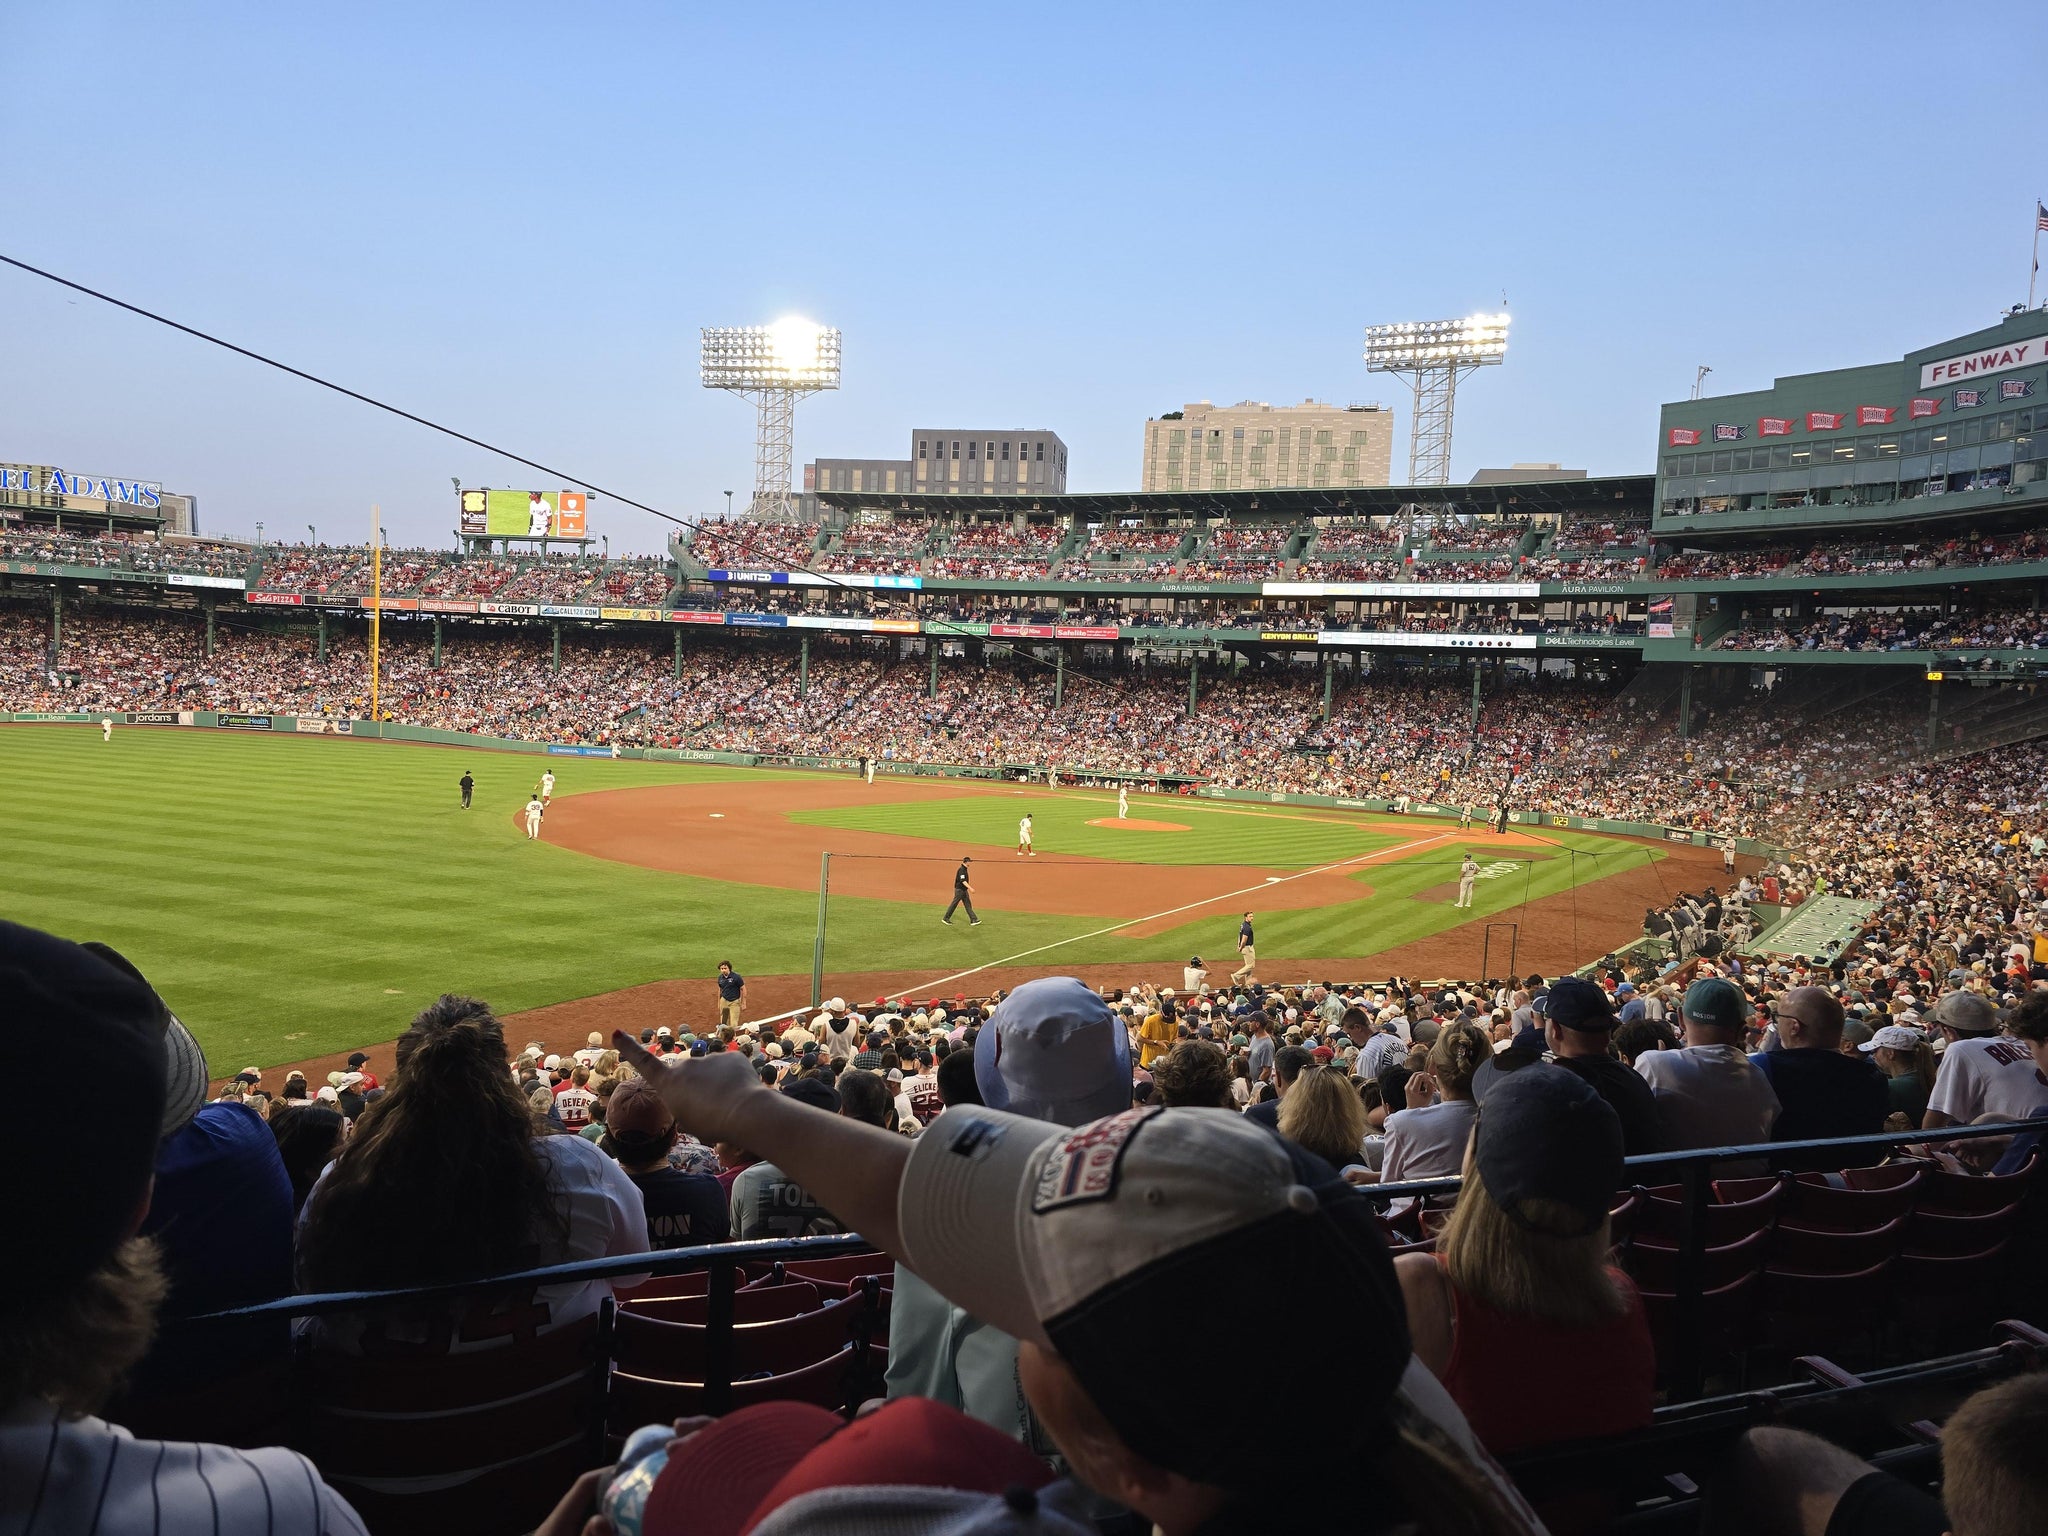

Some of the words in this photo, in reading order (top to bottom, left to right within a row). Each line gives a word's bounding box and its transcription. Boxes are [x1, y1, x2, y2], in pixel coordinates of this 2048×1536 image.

[1932, 345, 2029, 381] FENWAY
[43, 469, 161, 509] ADAMS
[272, 596, 295, 604] PIZZA
[422, 601, 443, 610] King's
[443, 602, 476, 611] Hawaiian
[1545, 637, 1567, 645] DELL
[1567, 637, 1614, 647] Technologies
[679, 751, 715, 760] L.L.Bean
[1692, 1010, 1716, 1020] BOSTON
[562, 1097, 591, 1107] DEVERS
[566, 1109, 582, 1120] 11
